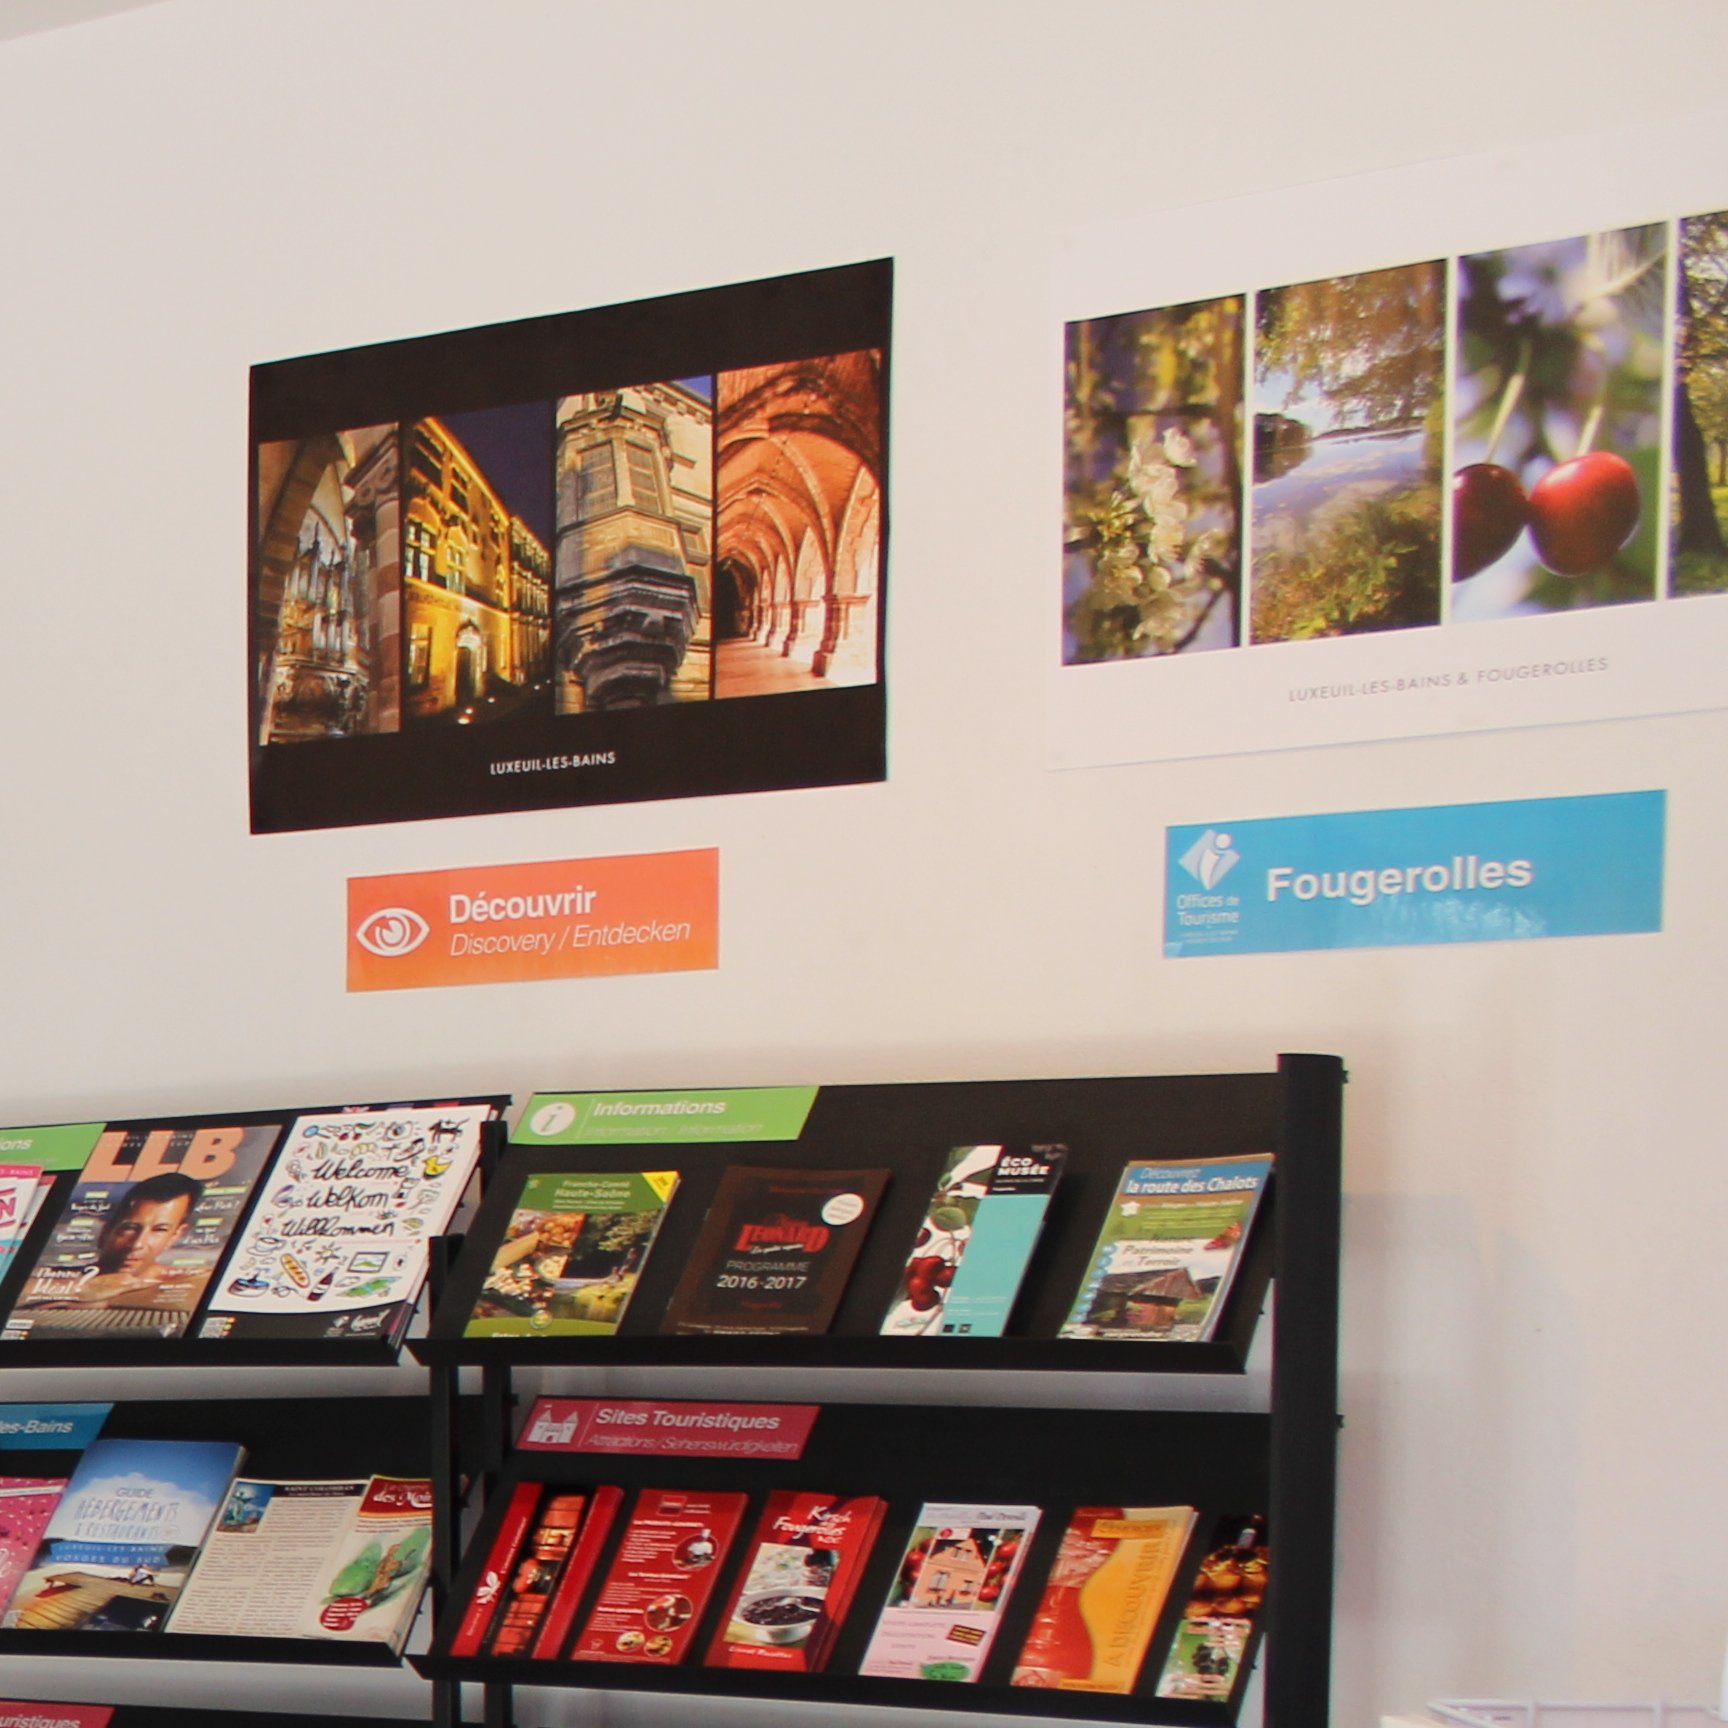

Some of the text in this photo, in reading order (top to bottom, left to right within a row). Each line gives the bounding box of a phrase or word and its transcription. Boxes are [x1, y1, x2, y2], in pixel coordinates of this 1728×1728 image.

[1289, 657, 1609, 703] LUXEUIL-LES-BAINS & FOUGEROLLES
[490, 751, 616, 775] LUXEUIL-LES-BAINS
[1267, 856, 1533, 905] Fougerolles
[449, 884, 597, 924] Découvrir
[1177, 893, 1223, 910] Offices
[1178, 909, 1239, 927] Tourisme
[450, 920, 690, 957] Discovery / Entdecken
[593, 1099, 727, 1118] Informations
[82, 1126, 244, 1183] LLB
[1001, 1155, 1033, 1167] ÉCO
[311, 1158, 411, 1181] Welcome
[997, 1163, 1051, 1177] MUSÉE
[1127, 1175, 1259, 1193] la route des Chalots
[726, 1261, 811, 1272] PROGRAMME
[596, 1408, 780, 1431] Sites Touristiques
[115, 1487, 156, 1499] GUIDE
